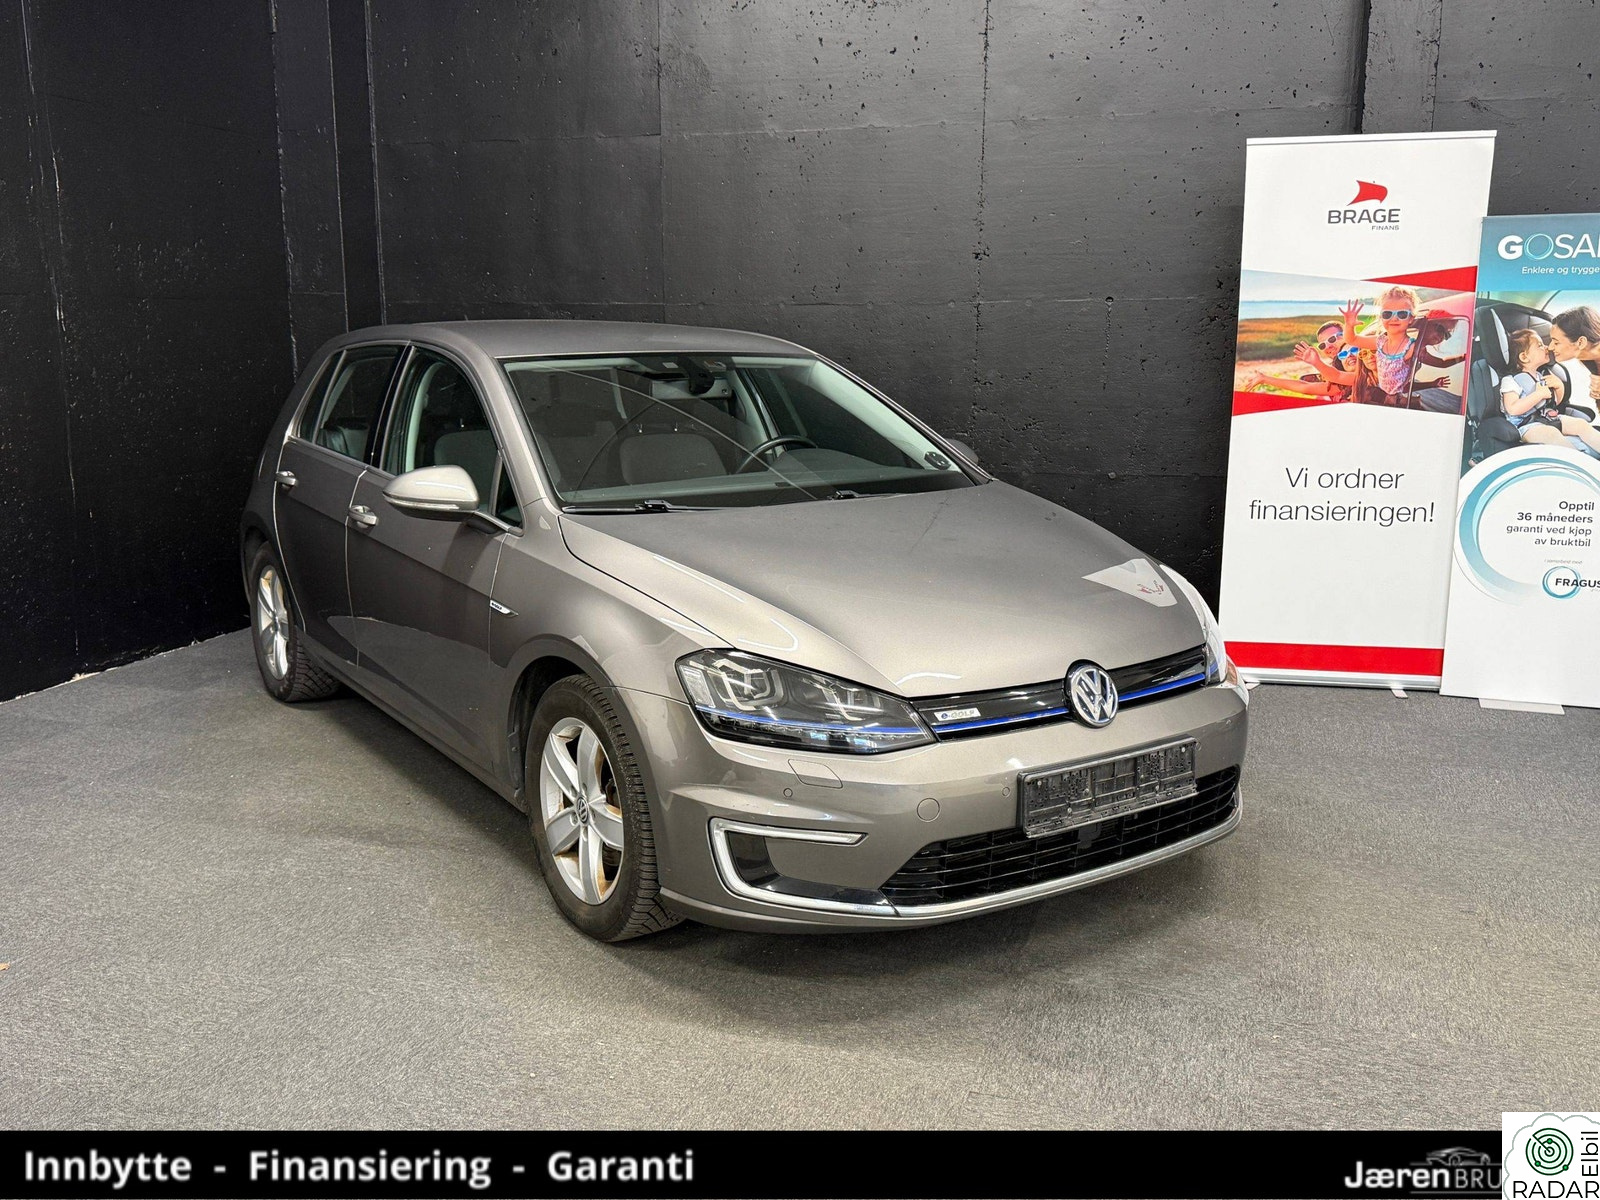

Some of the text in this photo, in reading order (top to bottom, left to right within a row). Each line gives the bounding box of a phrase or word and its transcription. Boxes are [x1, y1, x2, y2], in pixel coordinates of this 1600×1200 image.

[1328, 208, 1401, 224] BRAGE
[1521, 266, 1554, 275] Enklere
[1557, 267, 1569, 275] og
[1285, 467, 1405, 489] Vi ordner
[1558, 500, 1595, 512] Opptil
[1249, 499, 1435, 528] finansieringen!
[1516, 512, 1593, 524] 36 måneders
[1506, 525, 1593, 537] garanti ved kjøp
[1549, 538, 1591, 547] bruktbil
